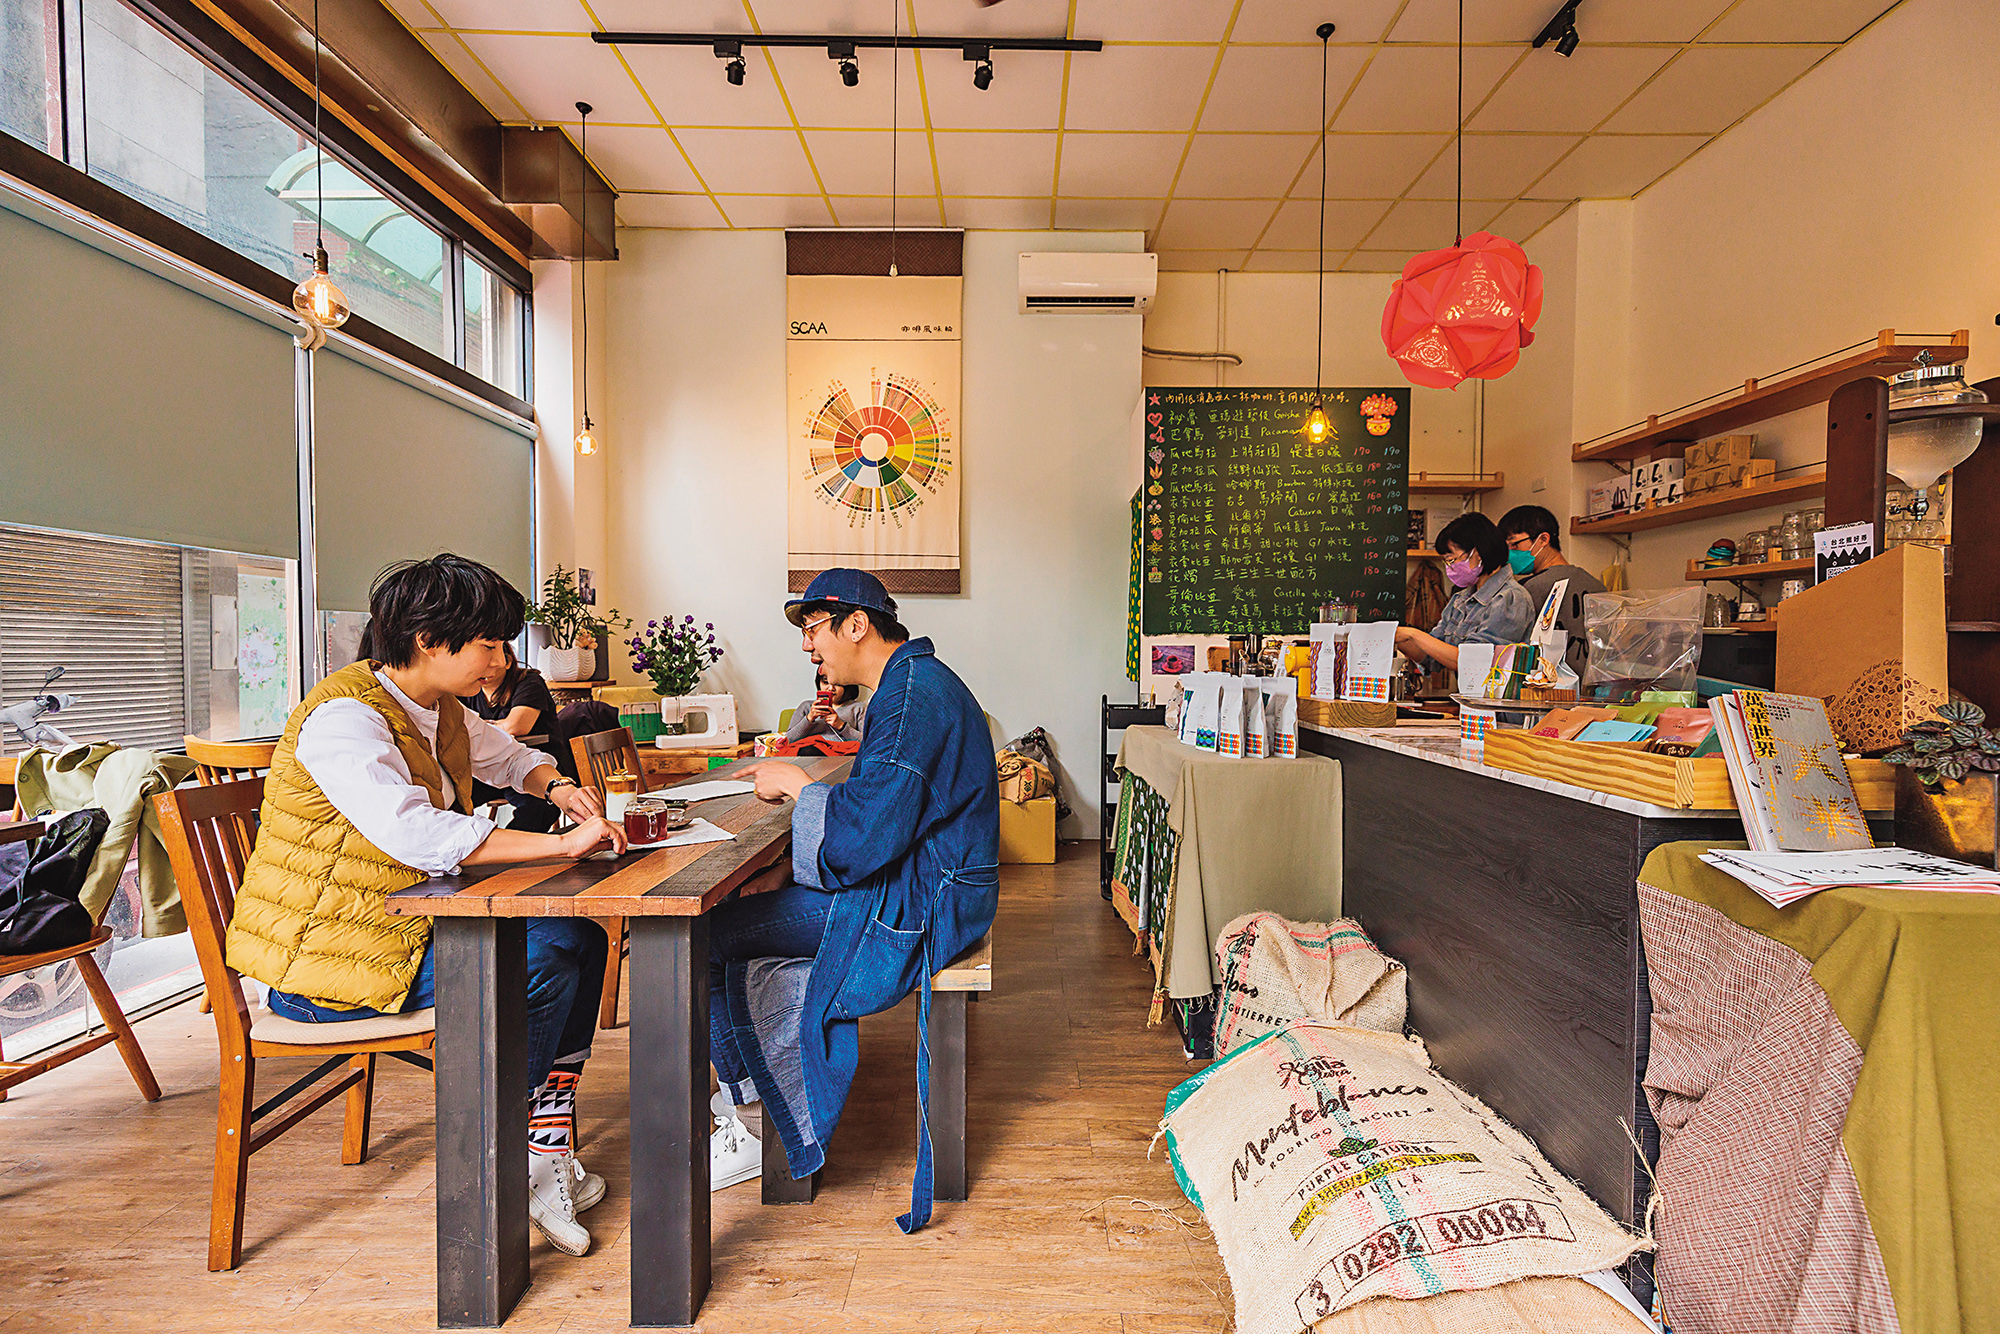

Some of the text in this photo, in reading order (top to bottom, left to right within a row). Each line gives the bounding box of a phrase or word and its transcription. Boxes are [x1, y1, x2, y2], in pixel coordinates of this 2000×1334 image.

[789, 321, 828, 335] SCAA
[1170, 445, 1217, 459] 瓜地馬拉
[1353, 447, 1370, 456] 170
[1384, 446, 1400, 456] 190
[1170, 463, 1218, 477] 尼加拉瓜
[1290, 464, 1313, 475] Java
[1367, 462, 1381, 471] 180
[1169, 480, 1216, 493] 瓜地馬拉
[1382, 477, 1396, 486] 170
[1170, 495, 1214, 508] 衣索比亞
[1367, 492, 1381, 500] 160
[1288, 506, 1323, 517] Caturra
[1367, 504, 1382, 513] 170
[1169, 524, 1217, 538] 尼加拉瓜
[1320, 521, 1341, 532] Java
[1363, 536, 1377, 544] 160
[1364, 551, 1378, 560] 150
[1384, 551, 1399, 560] 170
[1364, 566, 1380, 575] 180
[1166, 585, 1221, 603] 哥倫比亞
[1273, 586, 1306, 598] Castillo
[1350, 590, 1365, 598] 150
[1377, 592, 1395, 601] 170
[1169, 603, 1218, 618] 衣索比亞
[1169, 620, 1194, 632] 印尼
[1232, 1084, 1428, 1202] Monteblanco
[1269, 1127, 1332, 1170] RODRIGO
[1298, 1143, 1436, 1200] PURPLE CATURRA
[1355, 1173, 1423, 1199] HUILA
[1310, 1202, 1546, 1317] 3 0292 00084
